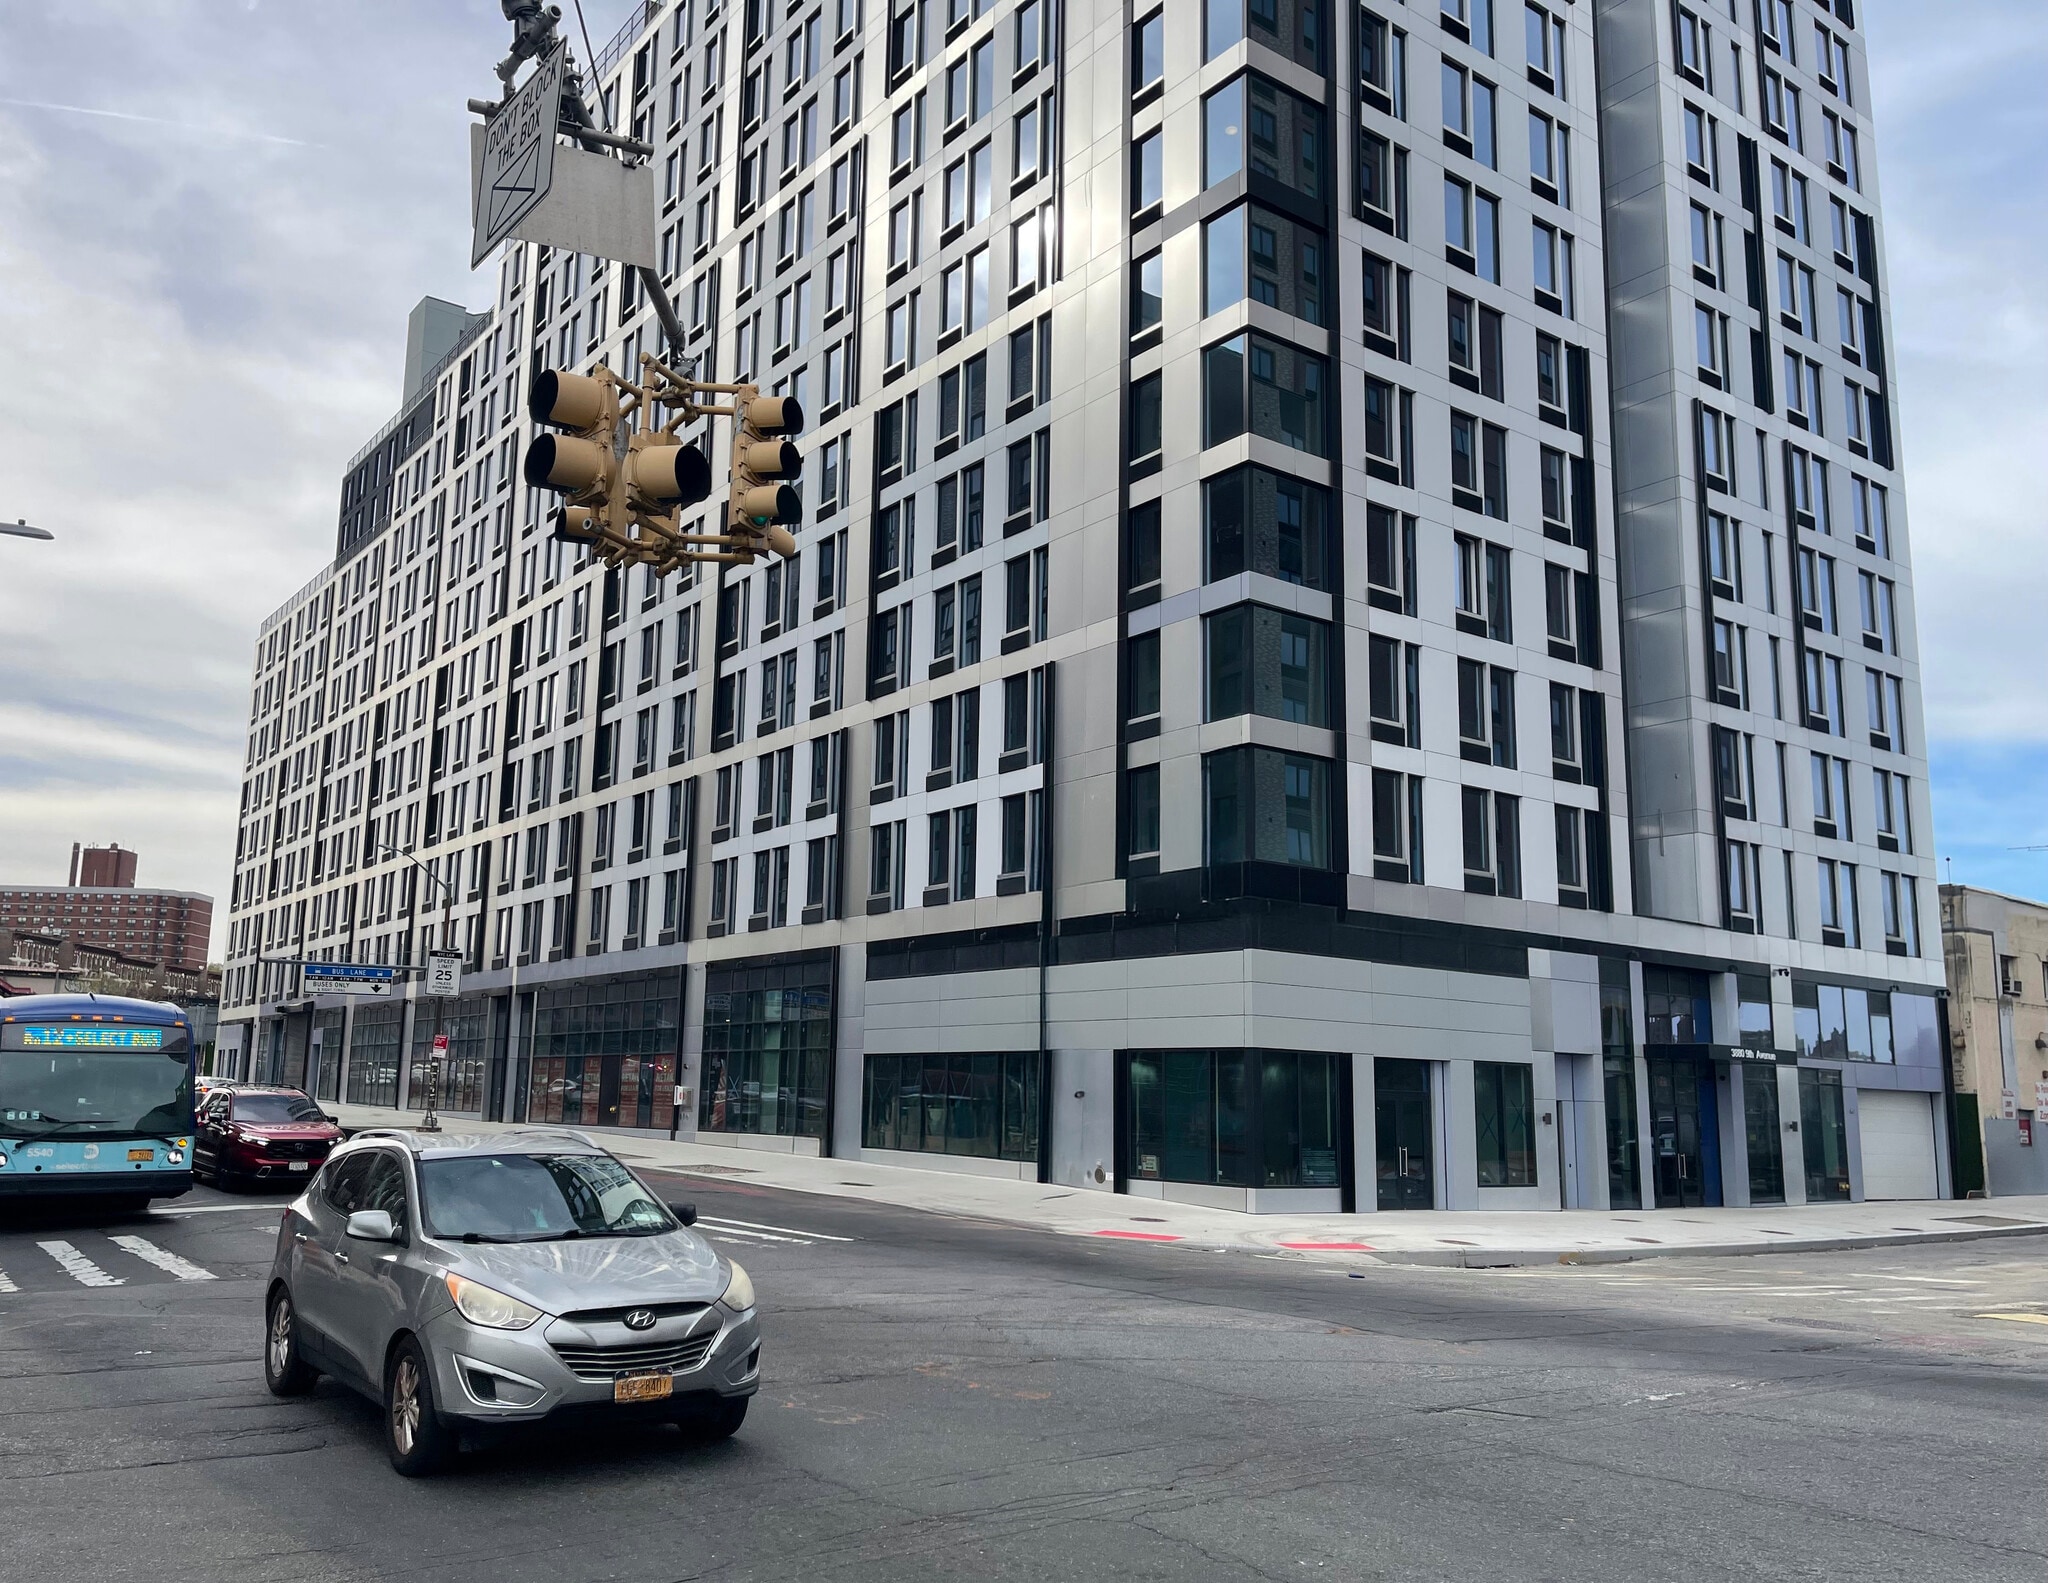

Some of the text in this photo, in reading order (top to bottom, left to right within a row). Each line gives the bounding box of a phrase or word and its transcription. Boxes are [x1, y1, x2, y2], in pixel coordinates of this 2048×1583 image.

[488, 56, 559, 155] DON'T BLOCK
[497, 103, 542, 172] THE BOX
[435, 969, 452, 981] 25
[1756, 1050, 1777, 1061] Avenue
[26, 1147, 54, 1158] 5540
